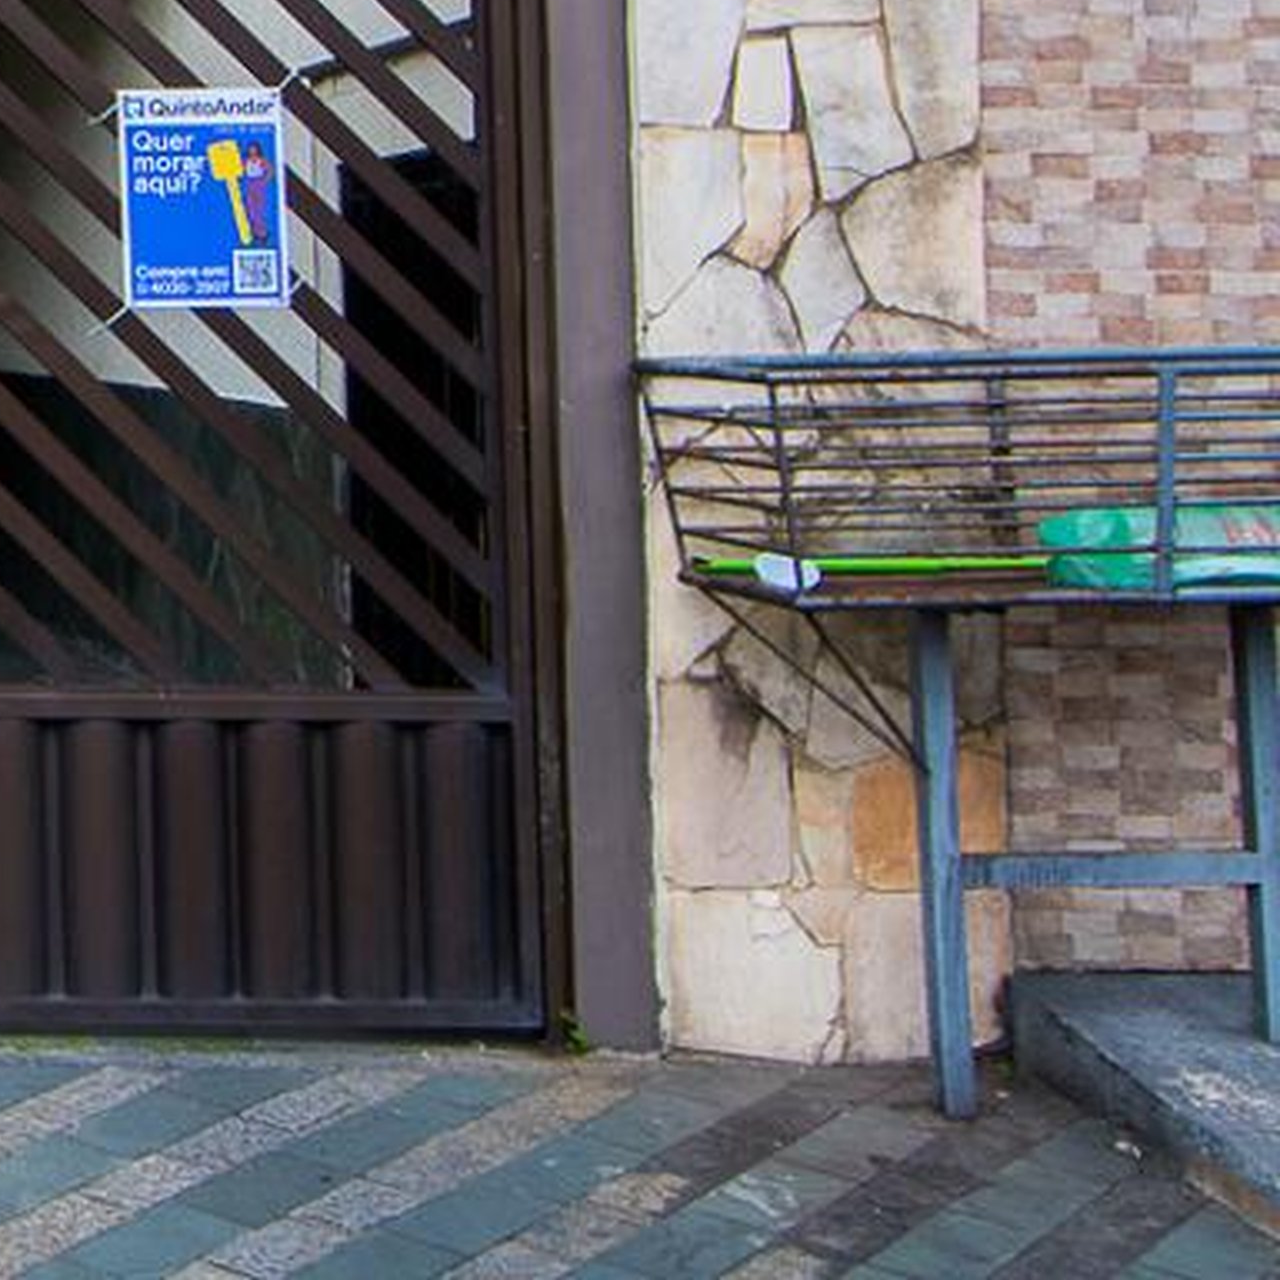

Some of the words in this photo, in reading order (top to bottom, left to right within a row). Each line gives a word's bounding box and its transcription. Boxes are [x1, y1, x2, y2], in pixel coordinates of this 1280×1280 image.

[149, 97, 274, 116] QuintoAndar
[132, 129, 193, 151] Quer
[133, 155, 207, 173] morar
[133, 172, 202, 198] aqui?
[135, 264, 198, 282] Compre
